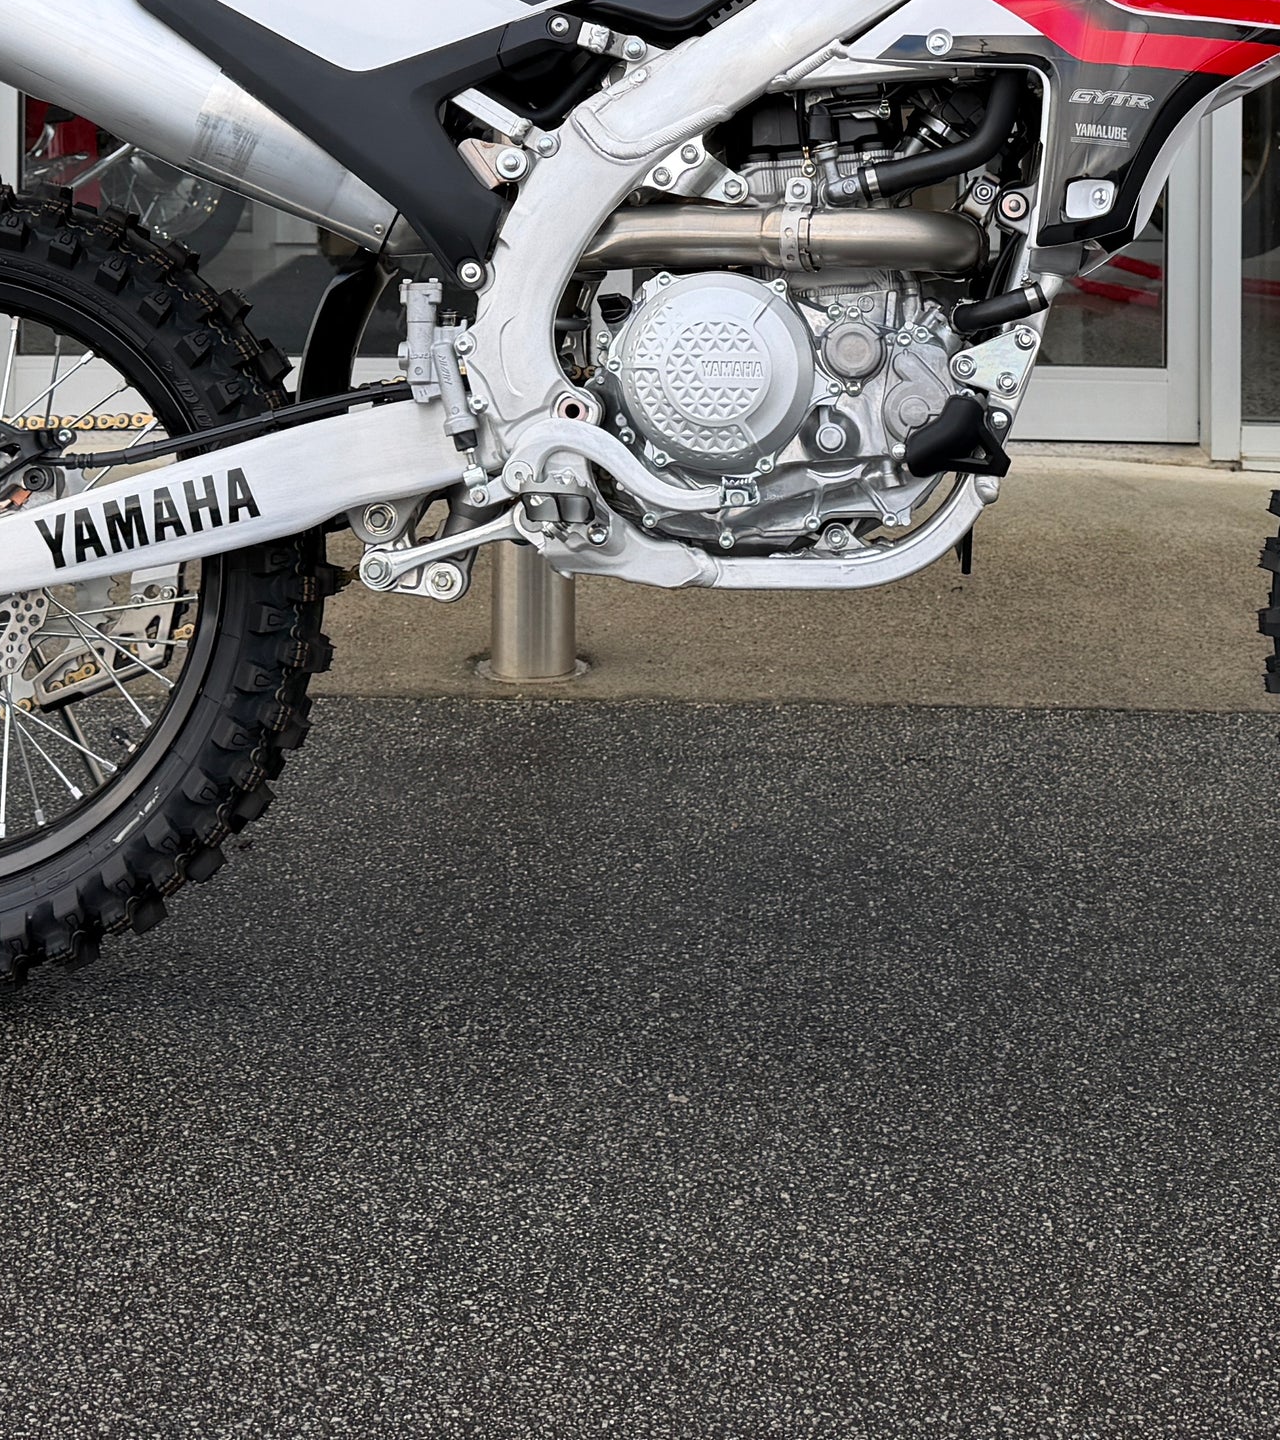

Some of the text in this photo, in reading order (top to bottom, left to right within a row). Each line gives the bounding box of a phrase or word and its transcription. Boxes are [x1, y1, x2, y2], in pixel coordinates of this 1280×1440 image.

[1068, 88, 1155, 110] GYTR
[1075, 122, 1128, 140] YAMALUBE
[701, 360, 764, 377] YAMAHA
[34, 467, 261, 569] YAMAHA
